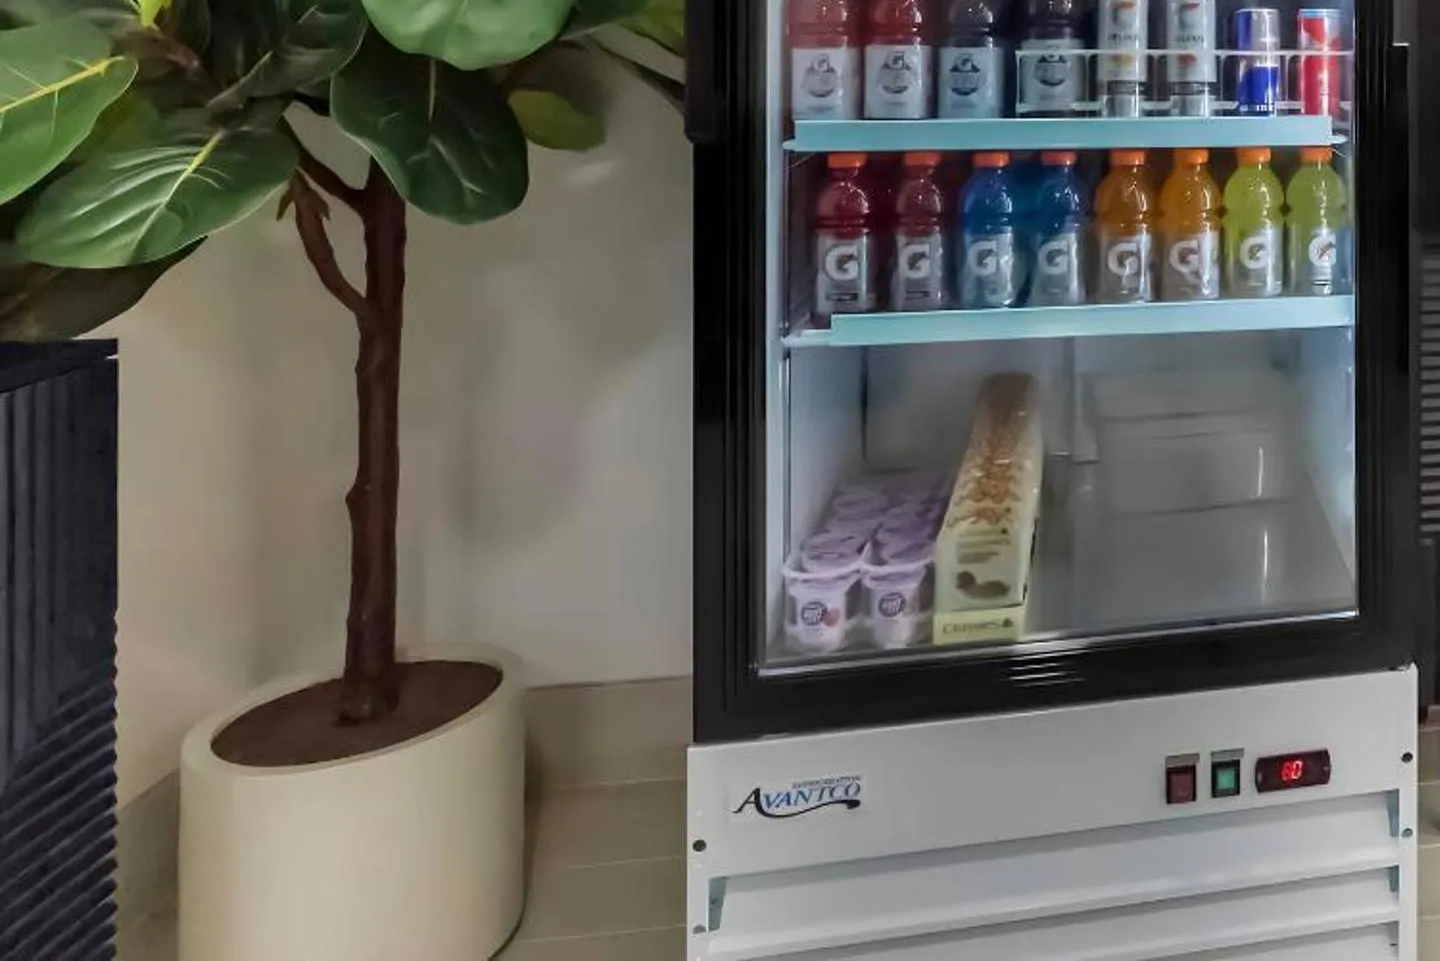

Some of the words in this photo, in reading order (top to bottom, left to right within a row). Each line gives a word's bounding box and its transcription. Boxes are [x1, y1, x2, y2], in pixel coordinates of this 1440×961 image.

[825, 244, 859, 281] G
[901, 243, 930, 279] G
[968, 240, 997, 276] G
[1037, 239, 1068, 275] G
[1107, 242, 1140, 276] G
[1169, 239, 1200, 273] G
[1239, 237, 1268, 270] G
[732, 782, 861, 819] AVANTCO
